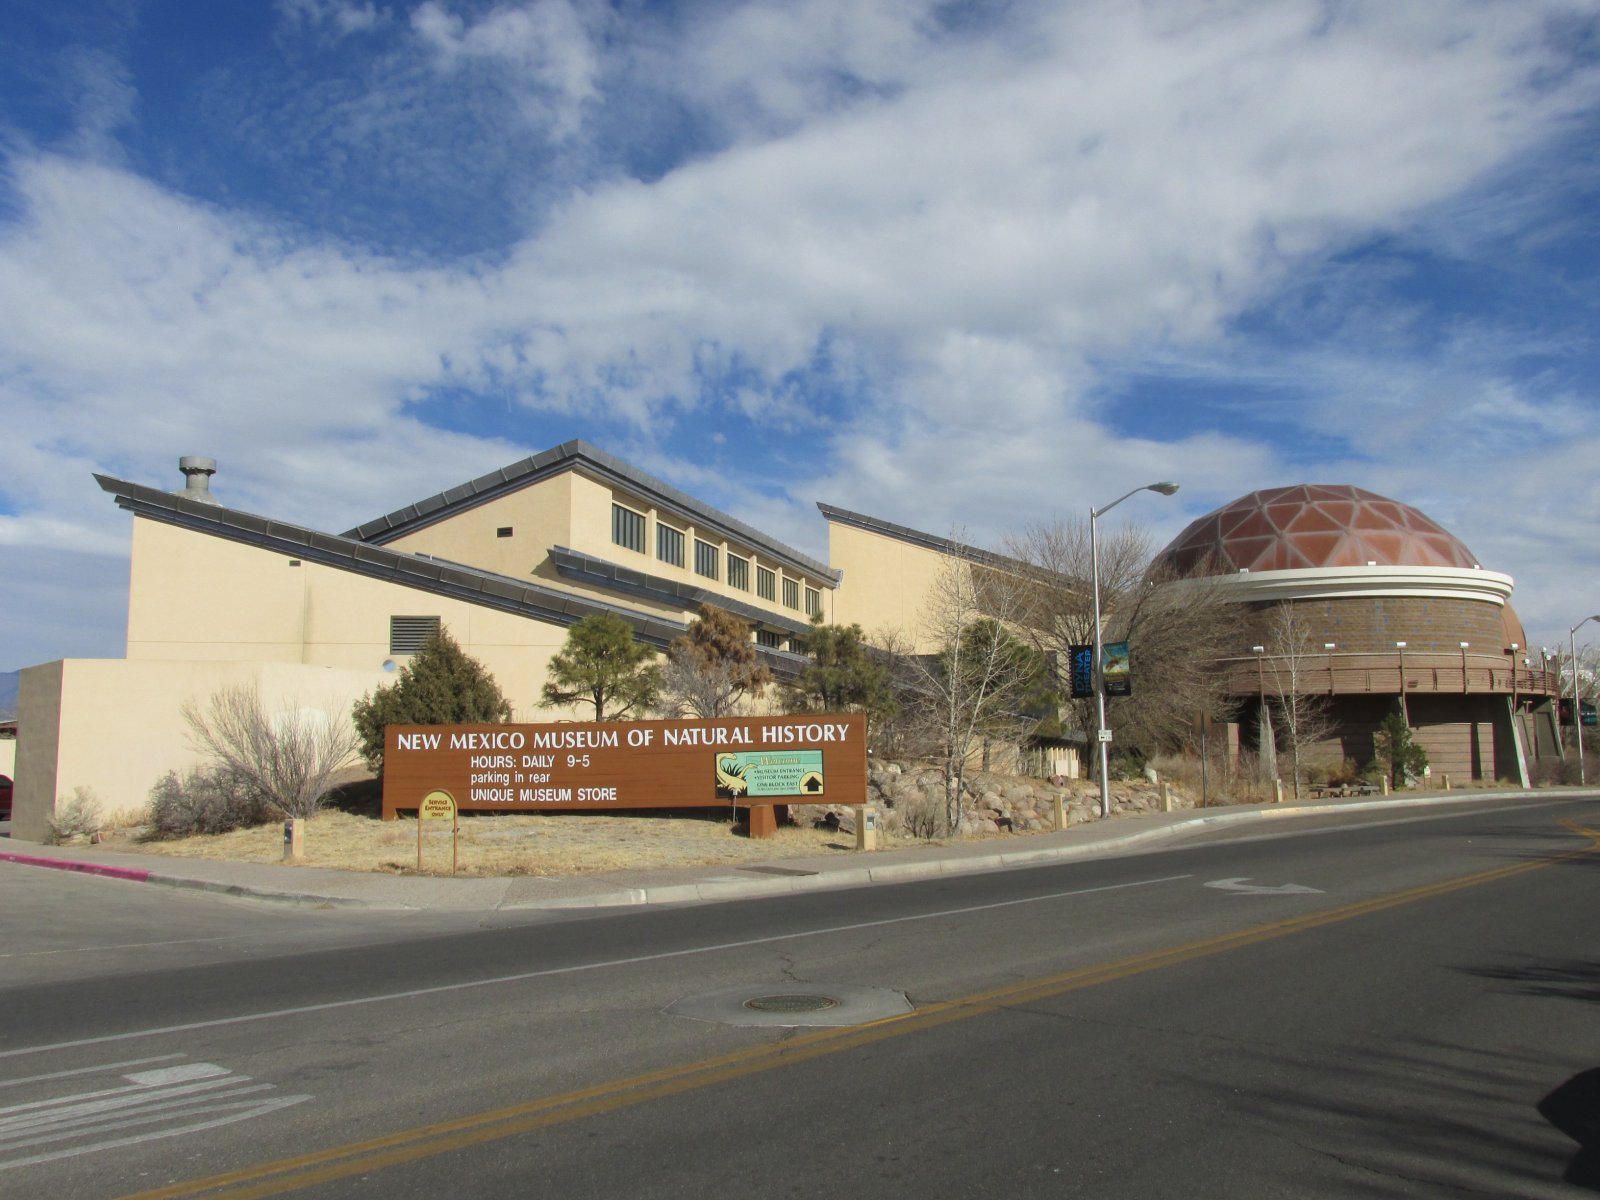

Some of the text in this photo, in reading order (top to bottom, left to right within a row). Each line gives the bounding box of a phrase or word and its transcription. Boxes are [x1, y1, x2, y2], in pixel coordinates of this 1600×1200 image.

[397, 724, 849, 750] NEW MEXICO MUSEUM OF NATURAL HISTORY
[471, 754, 590, 768] HOURS: DAILY 9-5
[471, 771, 550, 785] parking in rear
[470, 787, 617, 802] UNIQUE MUSEUM STORE
